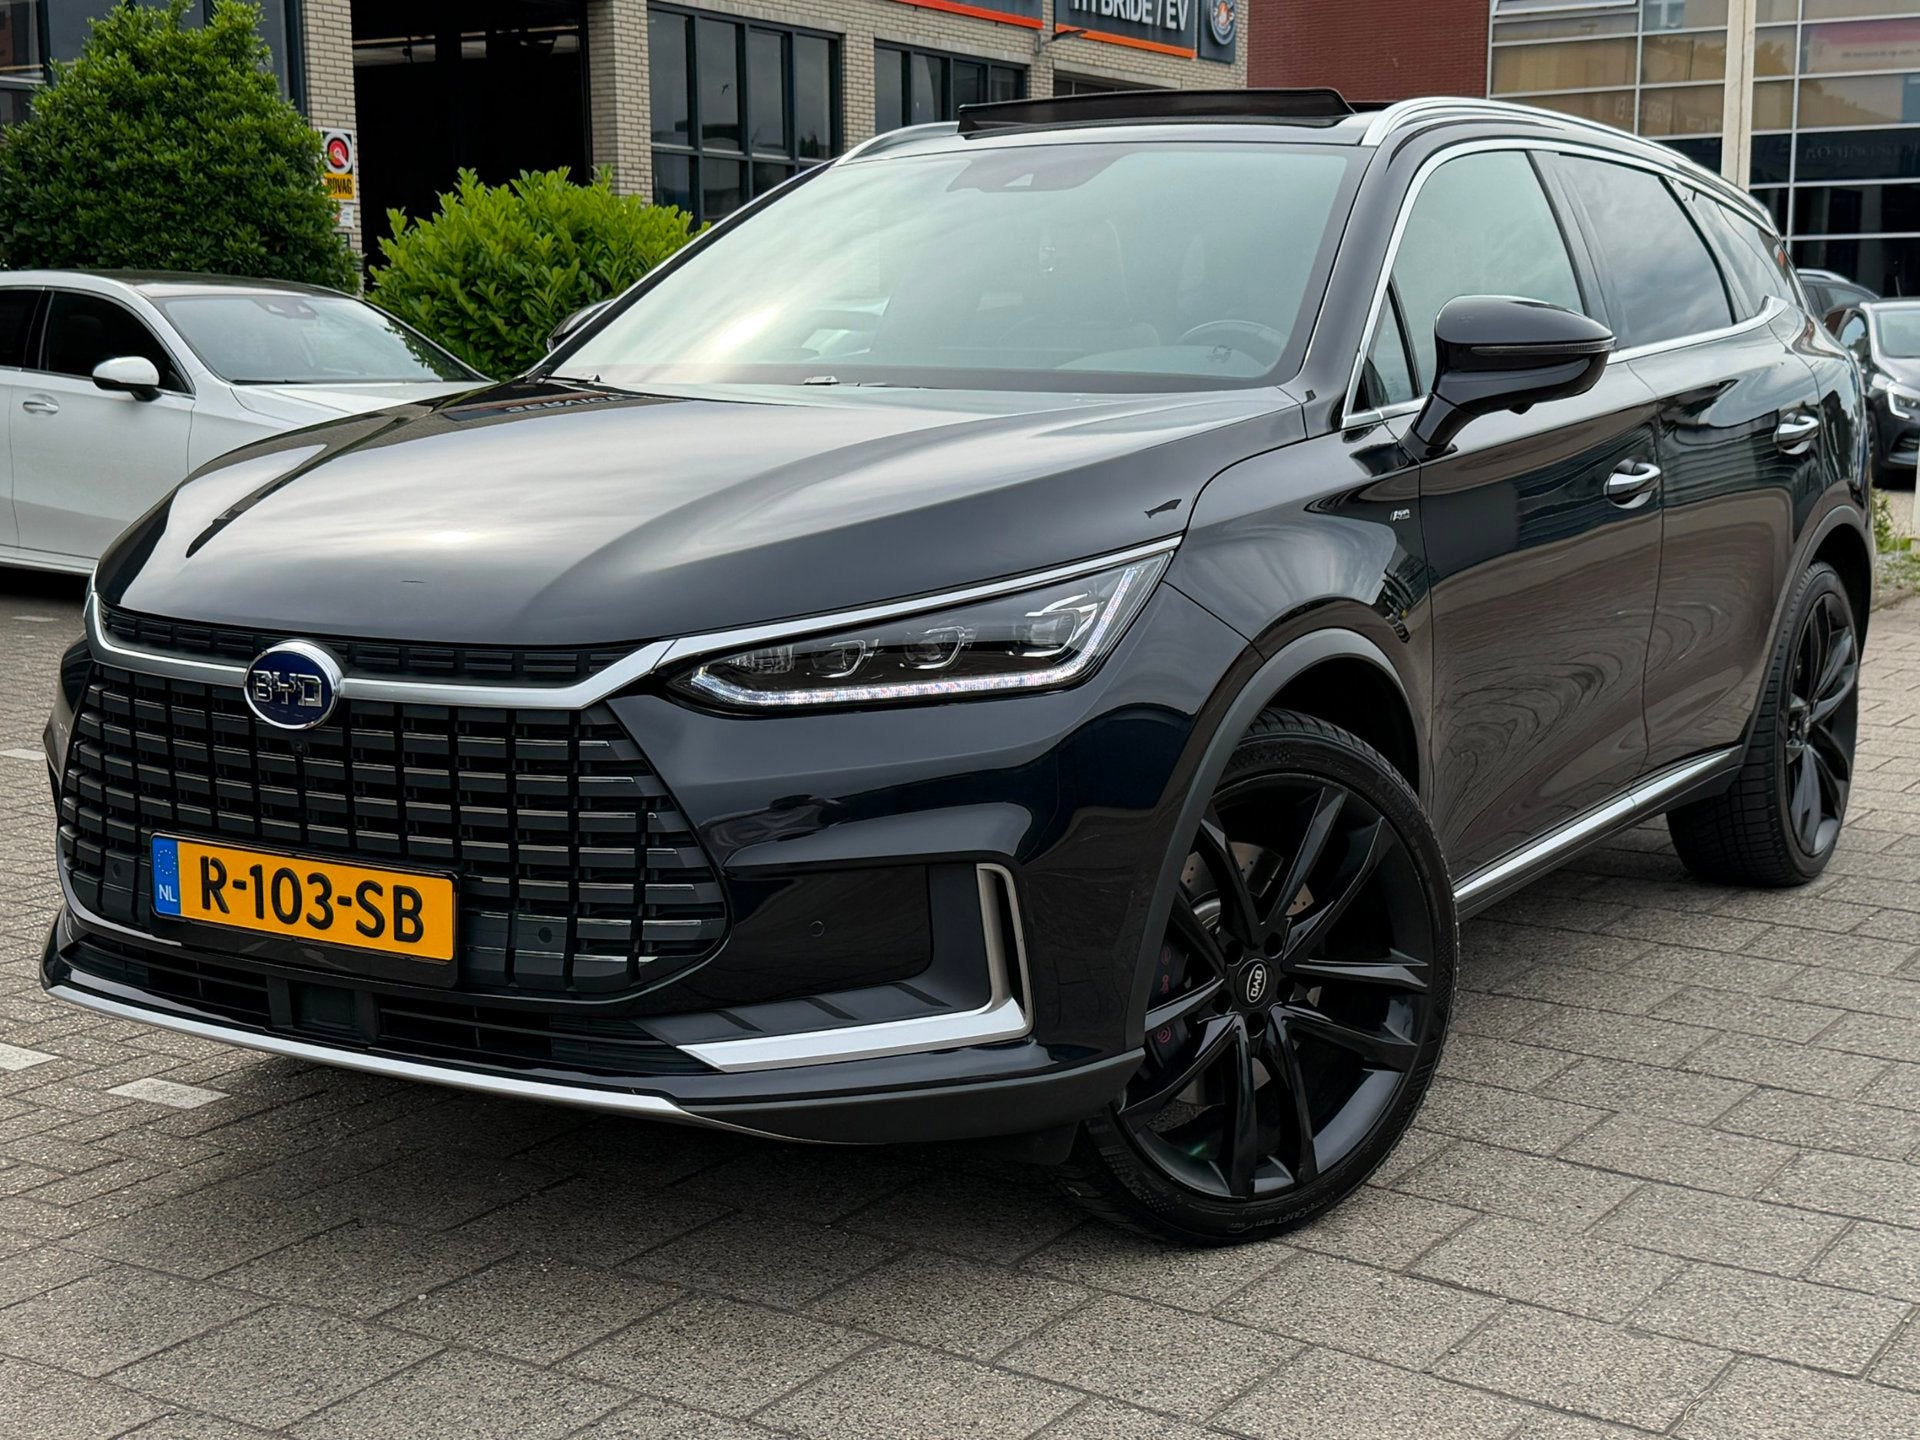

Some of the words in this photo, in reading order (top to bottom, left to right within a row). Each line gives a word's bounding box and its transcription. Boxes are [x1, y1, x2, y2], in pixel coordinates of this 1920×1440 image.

[252, 670, 322, 707] BYD
[158, 884, 177, 902] NL
[200, 855, 424, 943] R-103-SB
[1250, 970, 1263, 997] BYD
